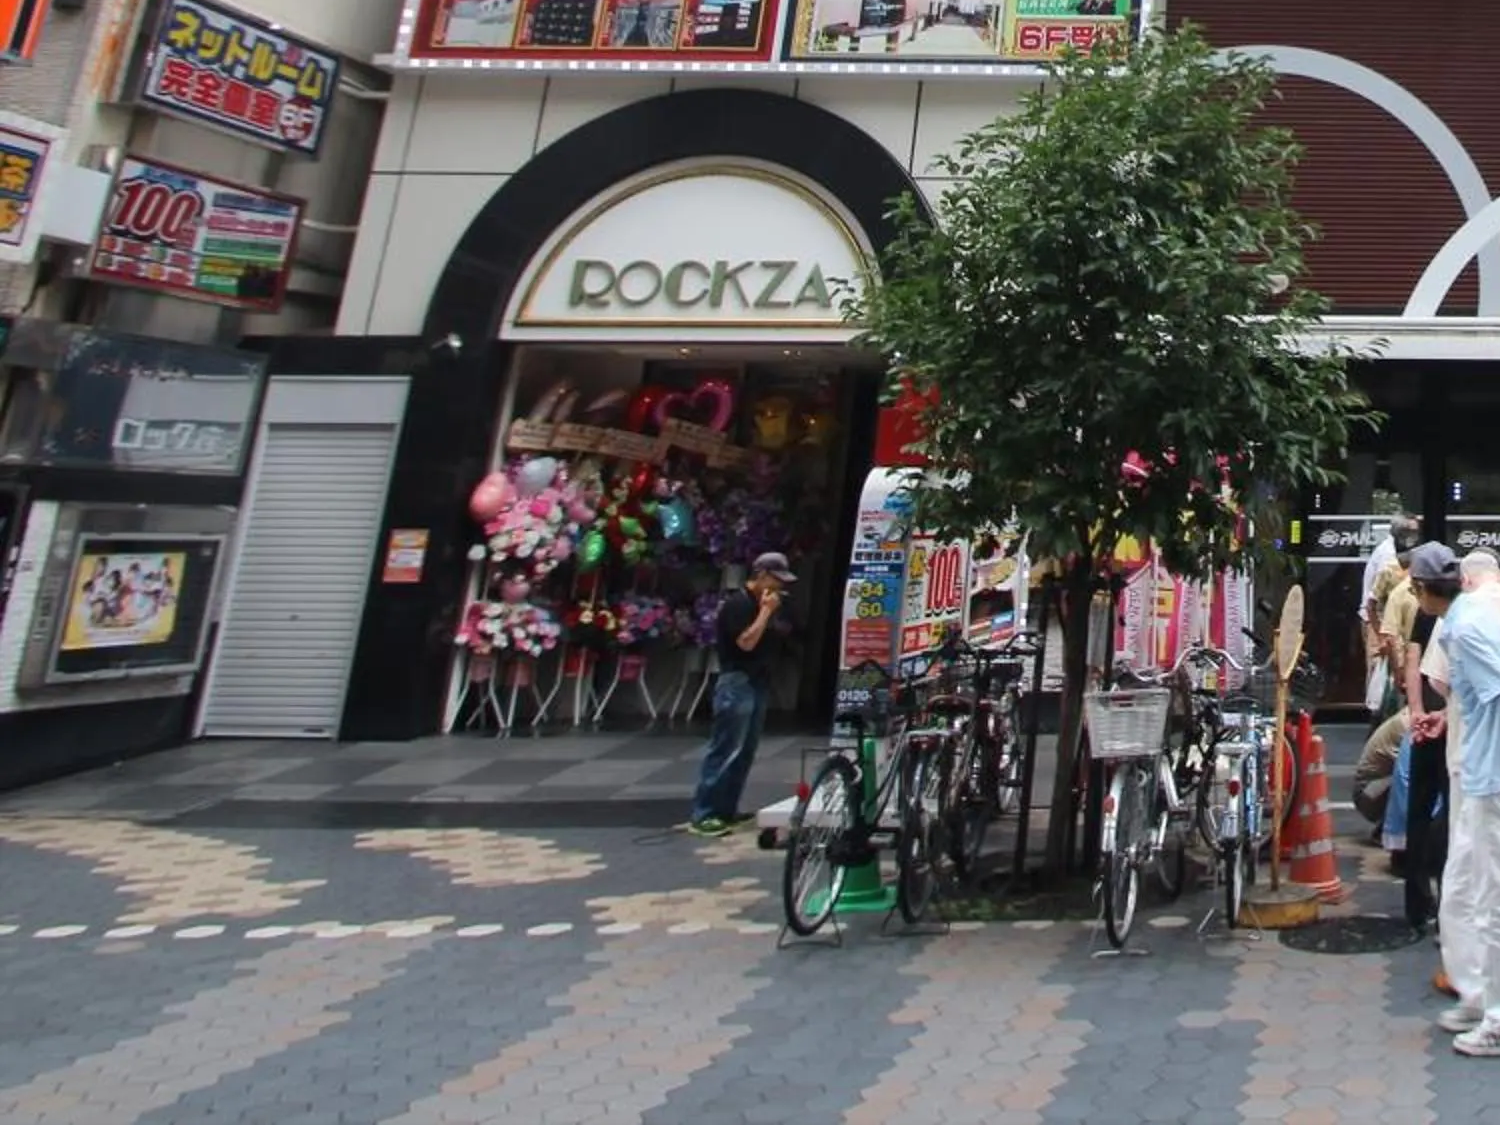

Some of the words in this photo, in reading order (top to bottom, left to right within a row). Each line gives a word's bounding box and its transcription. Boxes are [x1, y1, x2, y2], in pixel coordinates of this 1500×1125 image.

[167, 9, 324, 102] ネットルーム
[159, 57, 279, 133] 完全個室
[569, 259, 832, 308] ROCKZA
